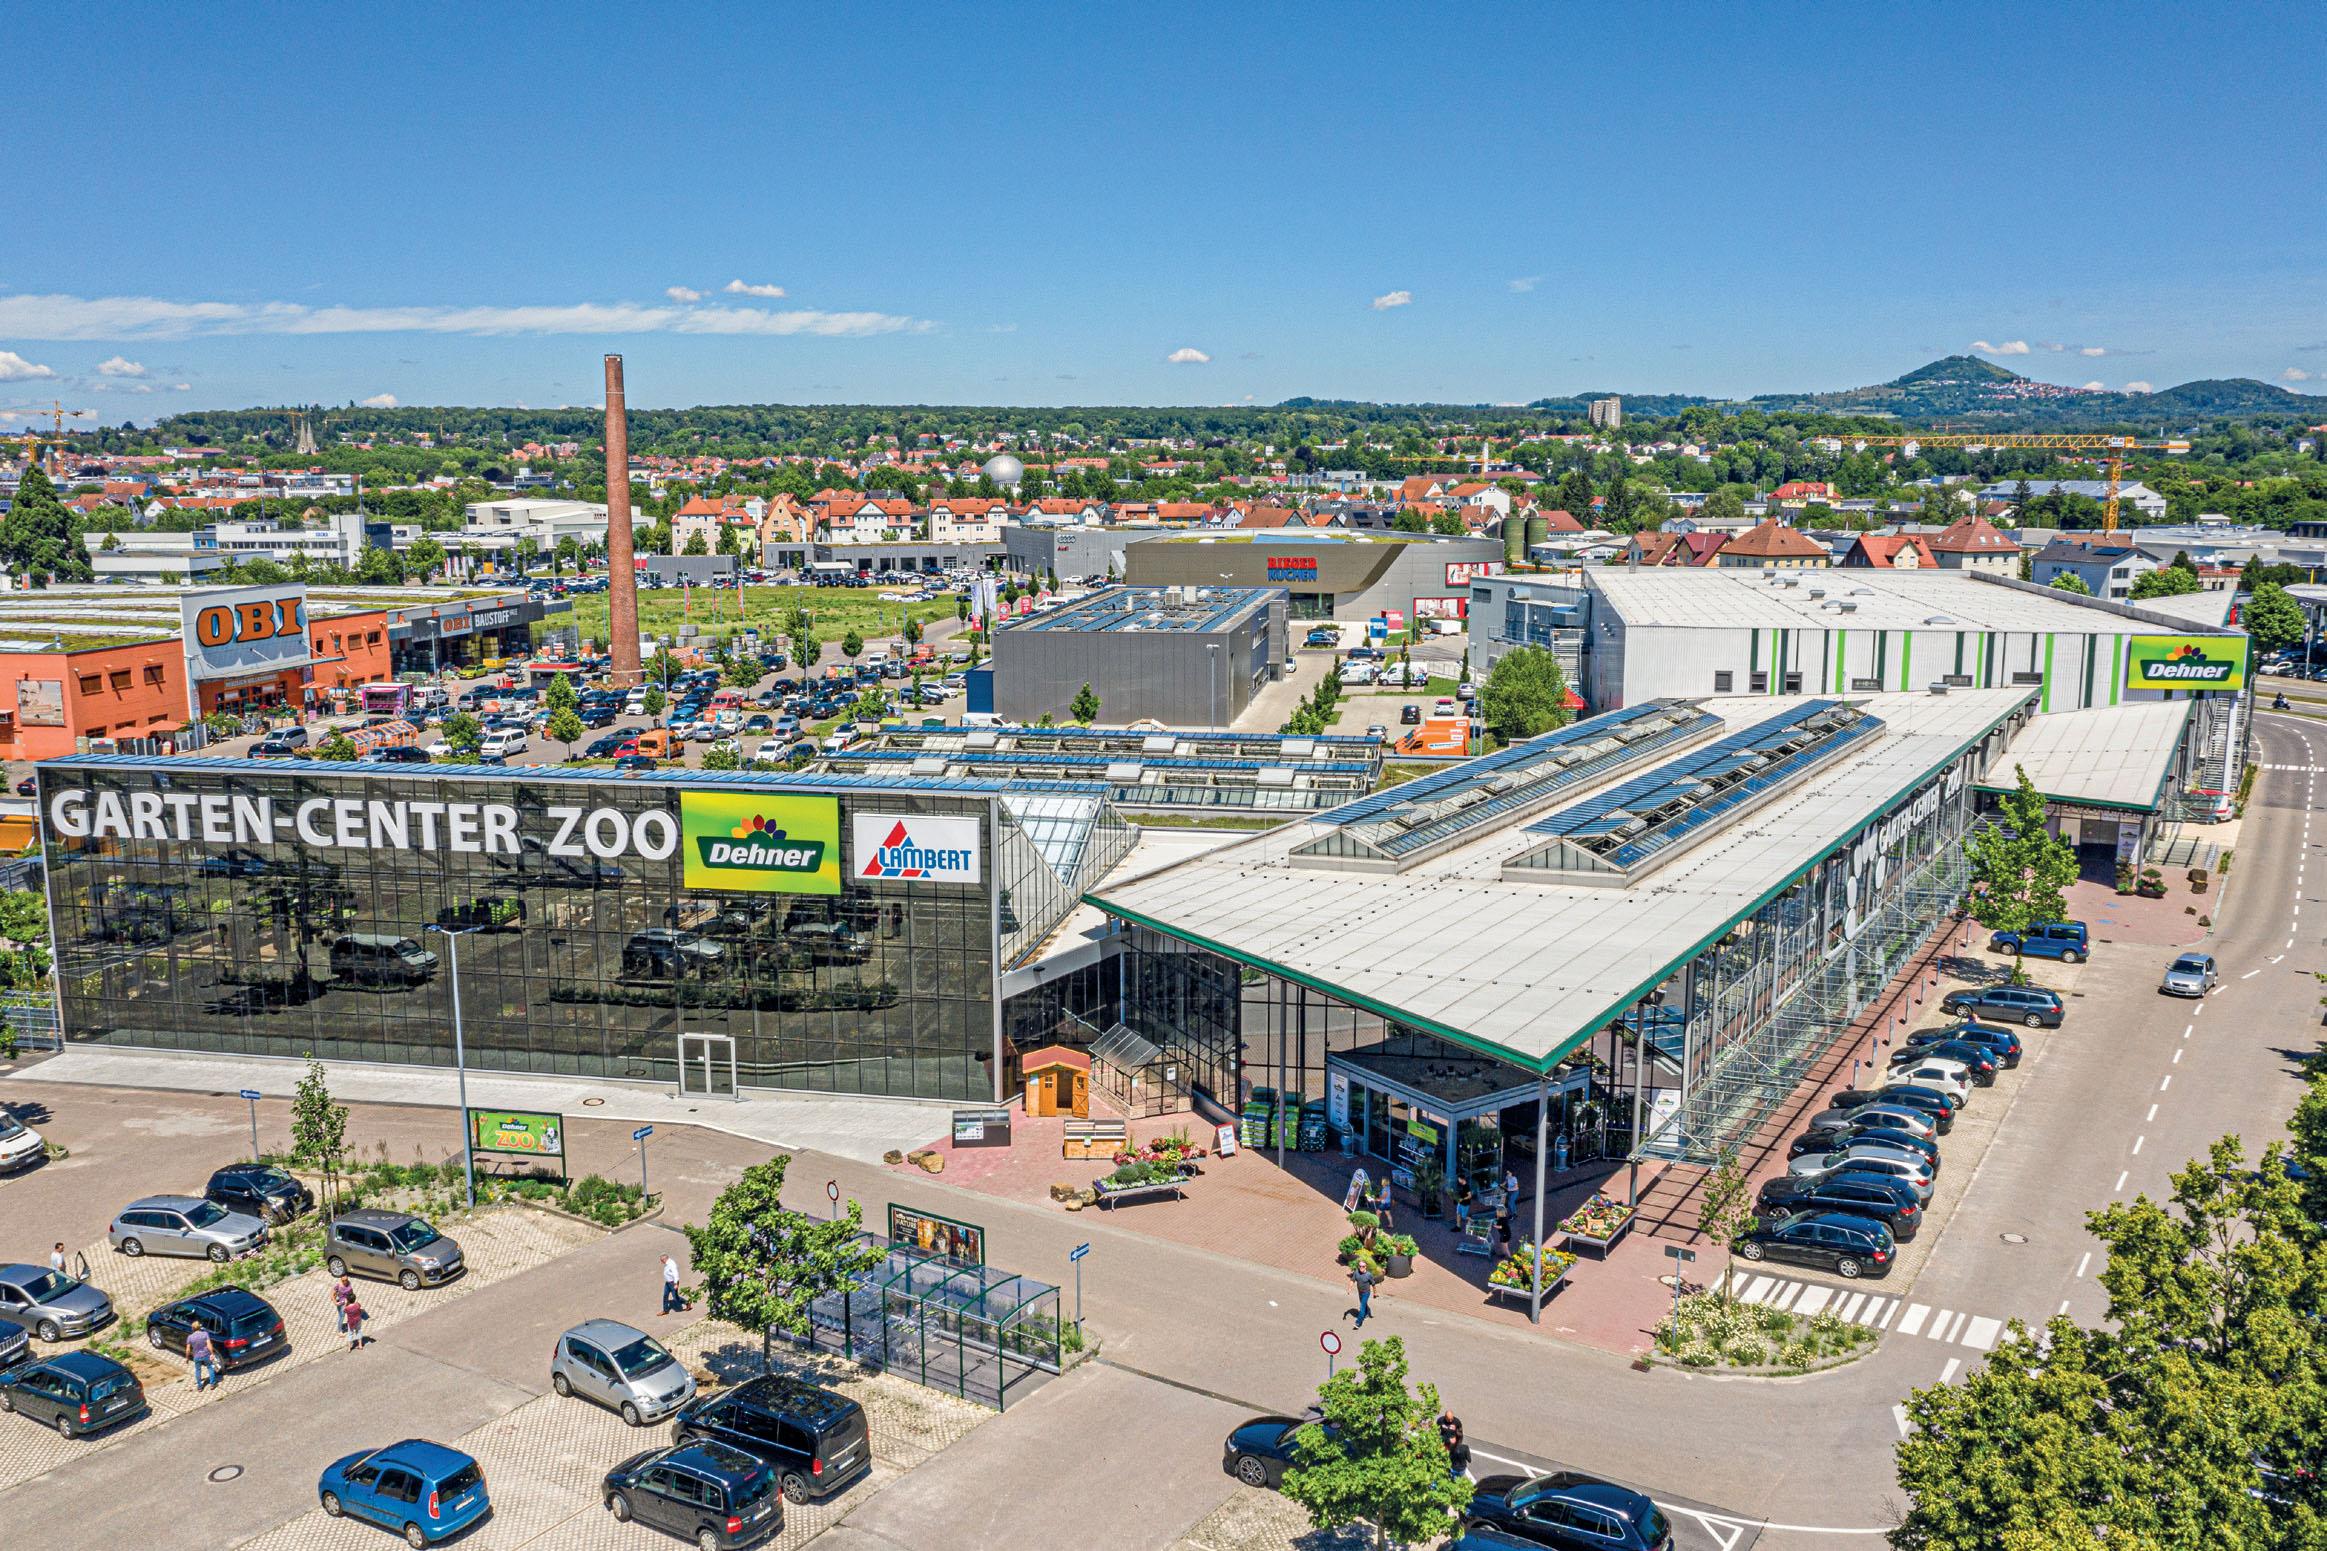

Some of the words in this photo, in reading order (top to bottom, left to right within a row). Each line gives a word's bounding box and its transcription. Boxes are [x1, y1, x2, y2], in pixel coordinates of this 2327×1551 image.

[1267, 557, 1317, 568] RIEGER
[197, 597, 303, 647] OBI
[442, 615, 470, 632] OBI
[474, 609, 509, 627] BAUSTOFF
[2147, 663, 2229, 678] Dehner
[50, 790, 522, 854] GARTEN-CENTER
[547, 807, 679, 860] ZOO
[709, 843, 817, 867] Dehner
[878, 847, 972, 871] LAMBERT
[495, 1130, 535, 1149] ZOO
